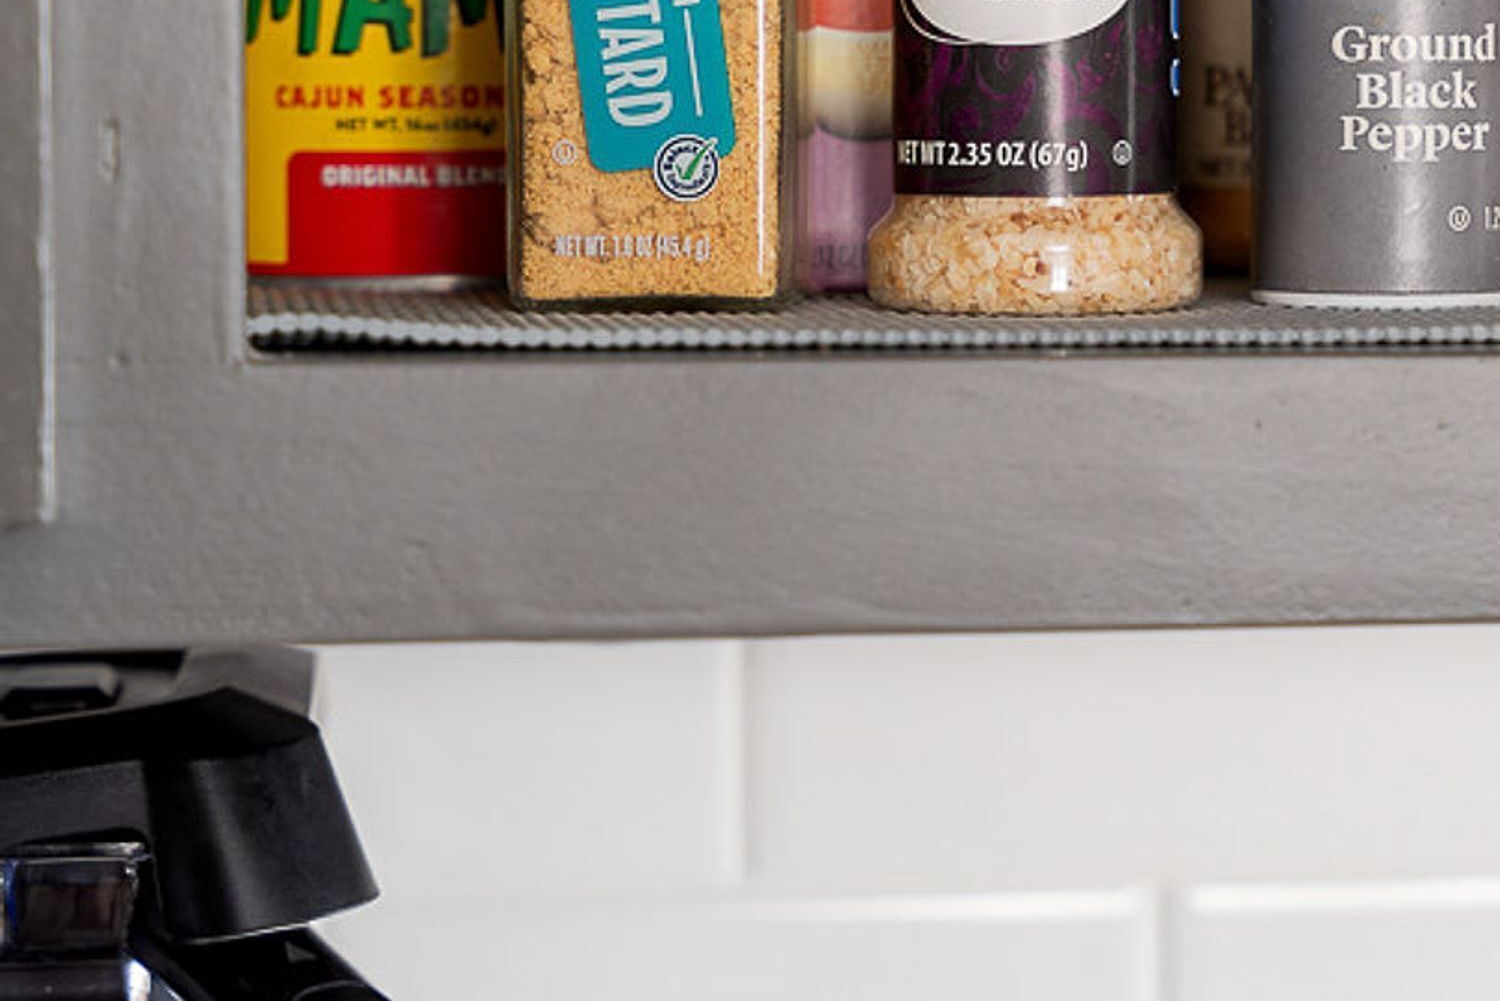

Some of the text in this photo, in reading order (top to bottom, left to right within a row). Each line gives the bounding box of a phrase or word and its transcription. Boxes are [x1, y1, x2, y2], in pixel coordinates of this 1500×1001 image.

[1331, 22, 1497, 63] Ground
[275, 84, 365, 109] CAJUN
[1355, 70, 1478, 110] Black
[948, 141, 992, 166] 2.35
[996, 141, 1025, 166] OZ
[1029, 139, 1088, 172] (67g)
[1339, 115, 1491, 164] Pepper
[321, 164, 430, 188] ORIGINAL
